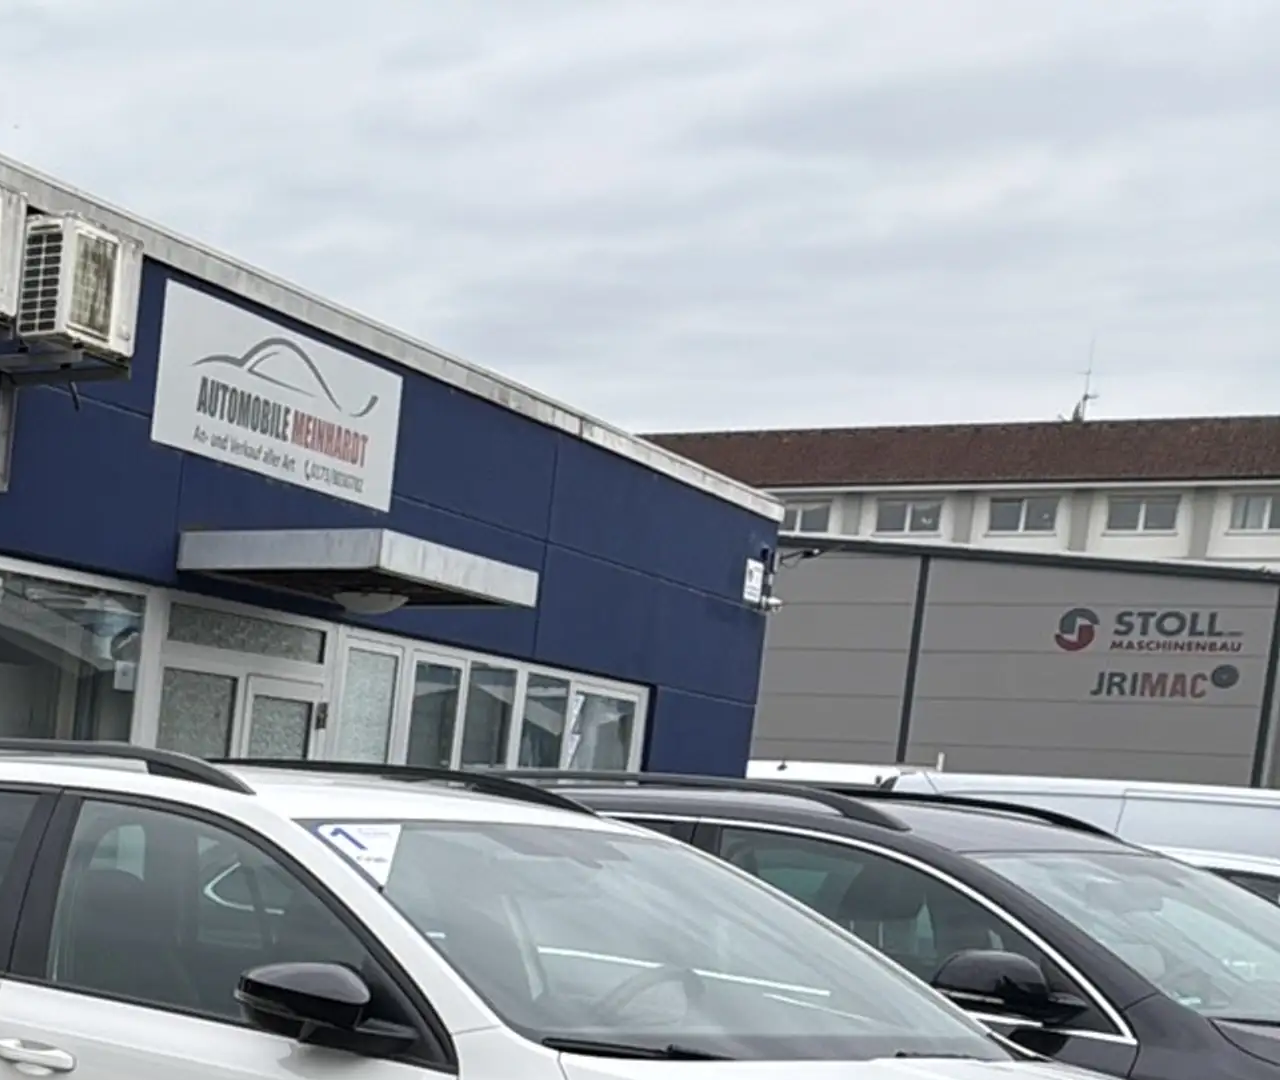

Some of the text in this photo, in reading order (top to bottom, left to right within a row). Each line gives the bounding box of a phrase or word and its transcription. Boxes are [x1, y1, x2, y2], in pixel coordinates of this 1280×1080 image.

[195, 376, 370, 469] AUTOMOBILE MEINHARDT
[1113, 610, 1225, 637] STOLL
[1110, 640, 1244, 653] MASCHINENBAU
[1090, 671, 1208, 699] JRIMAC
